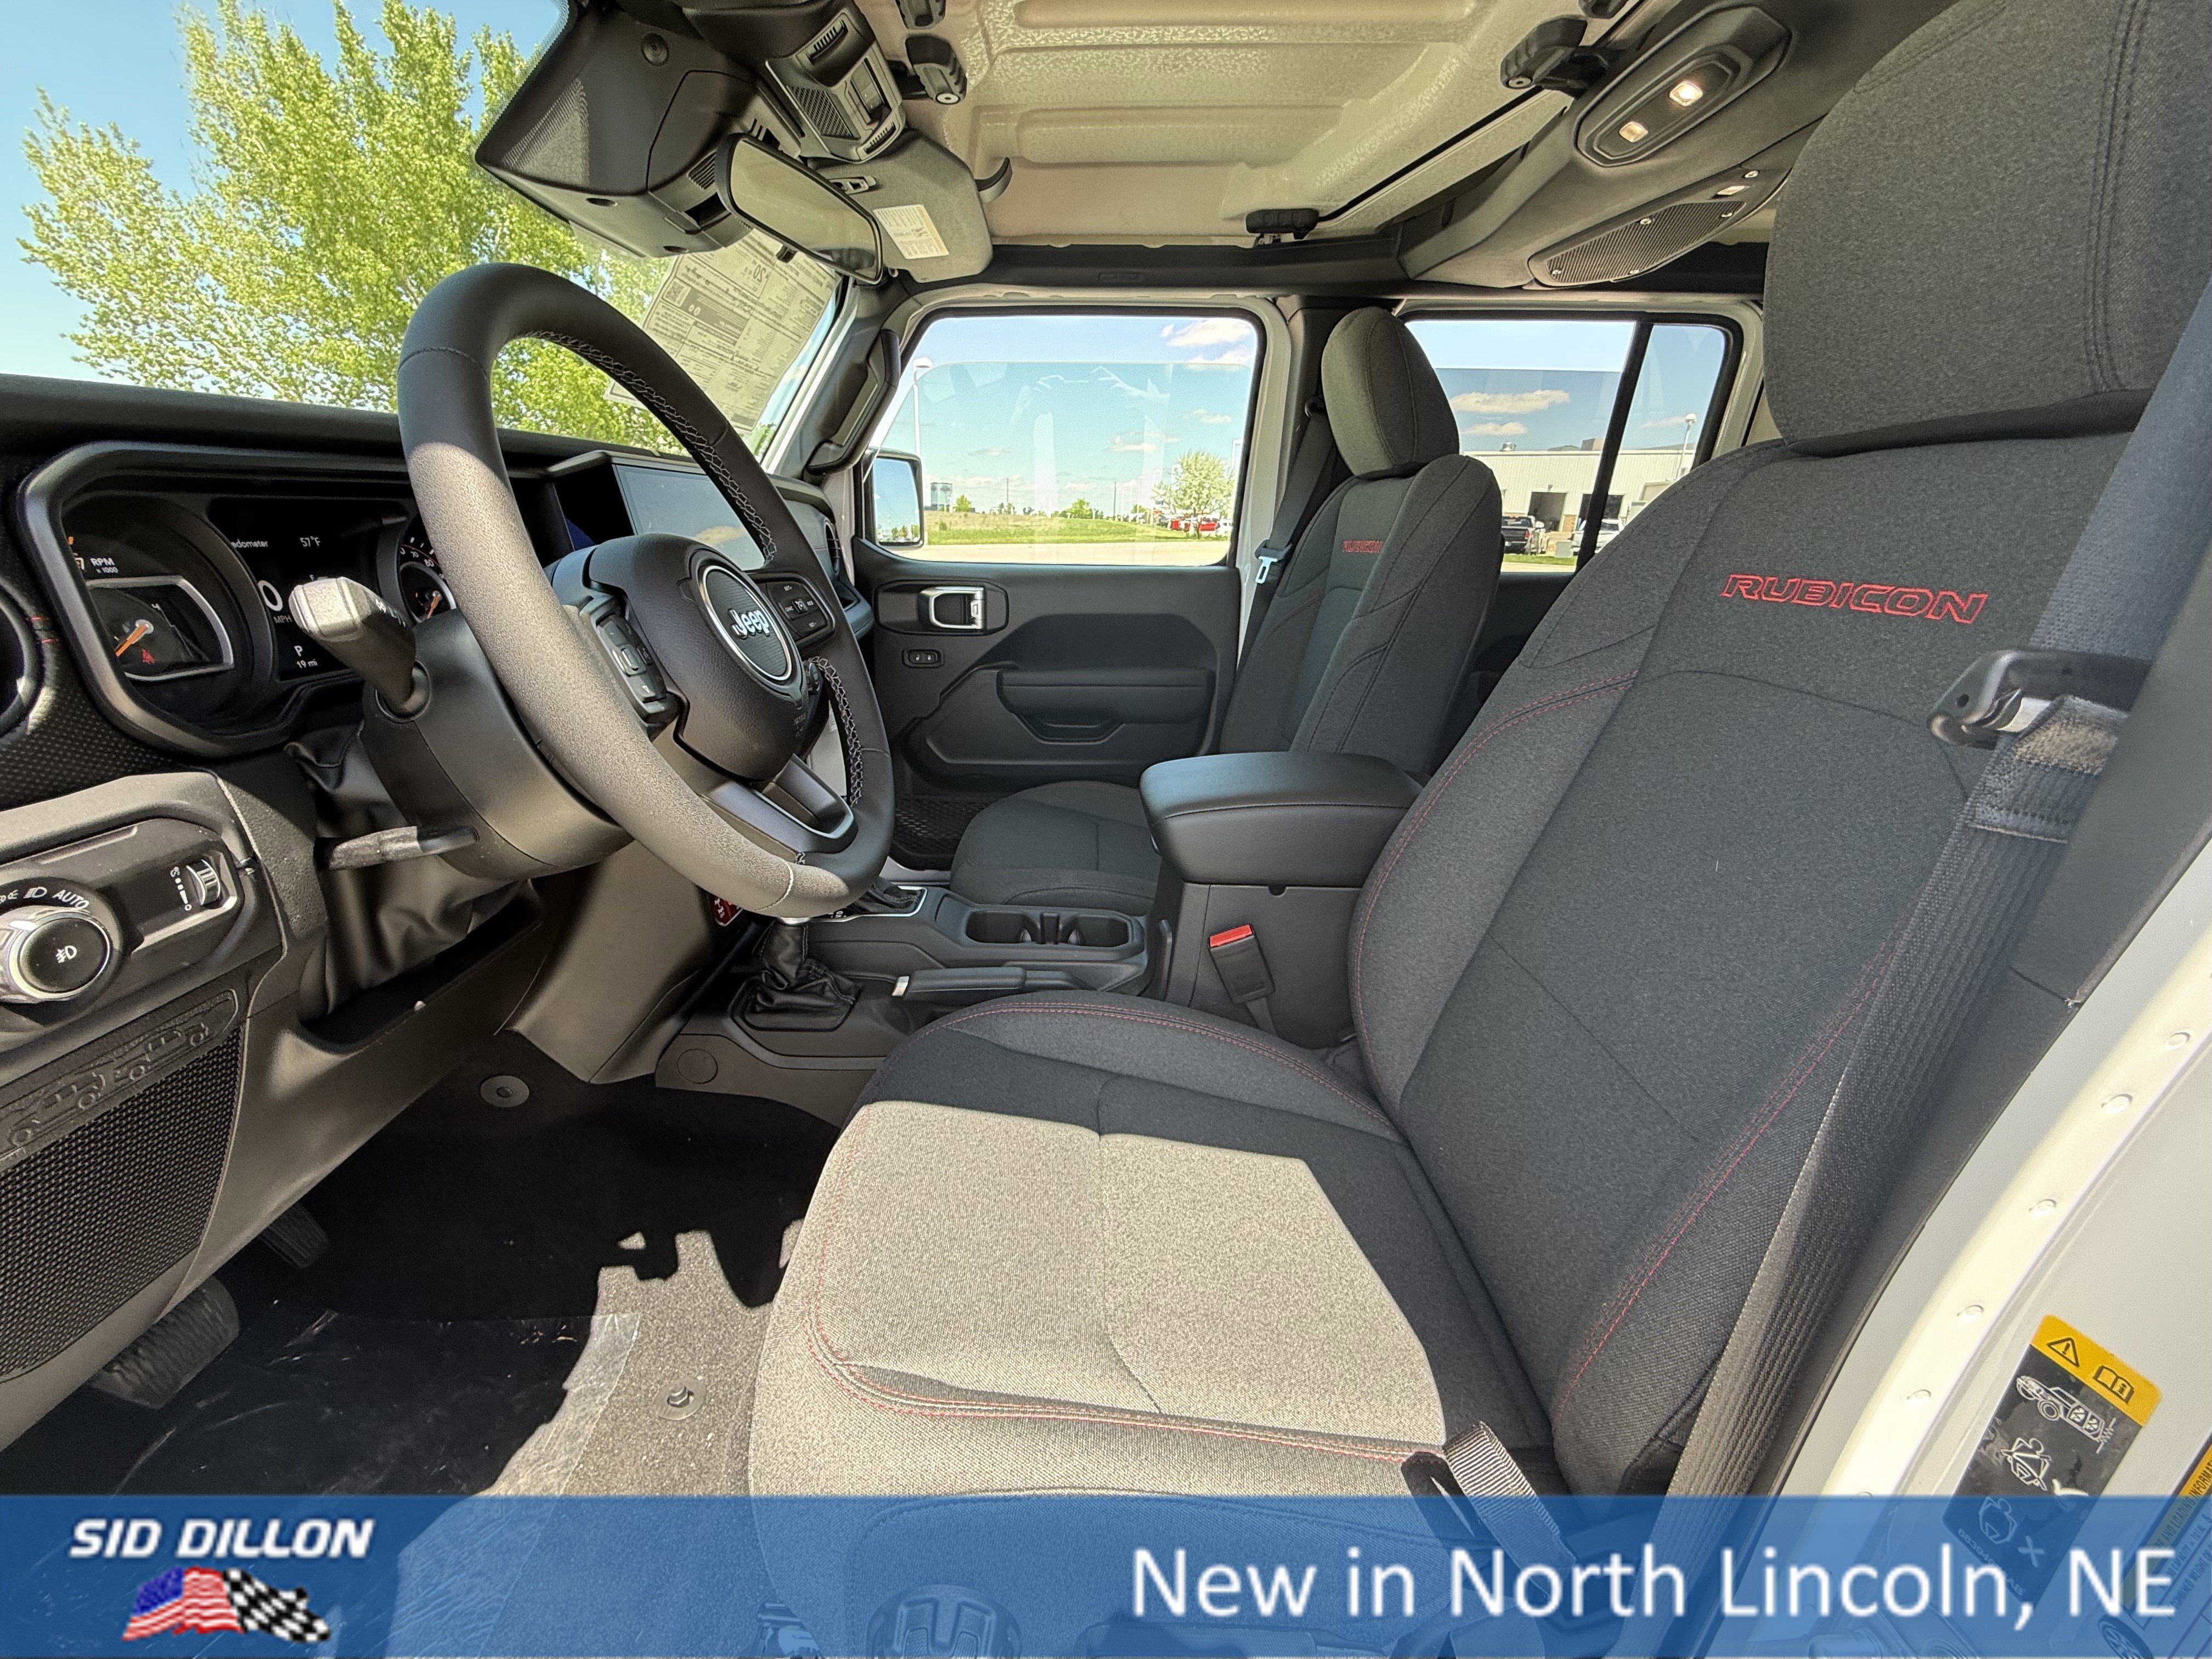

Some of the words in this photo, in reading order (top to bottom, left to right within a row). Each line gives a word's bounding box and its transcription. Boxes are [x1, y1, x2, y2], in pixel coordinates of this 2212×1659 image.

[90, 557, 115, 566] RPM
[1721, 574, 1988, 624] RUBICON
[274, 615, 293, 624] MPH
[728, 609, 770, 639] Jeep
[294, 645, 303, 657] P
[296, 661, 306, 669] 19
[308, 659, 318, 667] mi
[52, 889, 89, 910] AUTO
[2159, 1523, 2178, 1543] AND
[2169, 1496, 2198, 1529] LOADING
